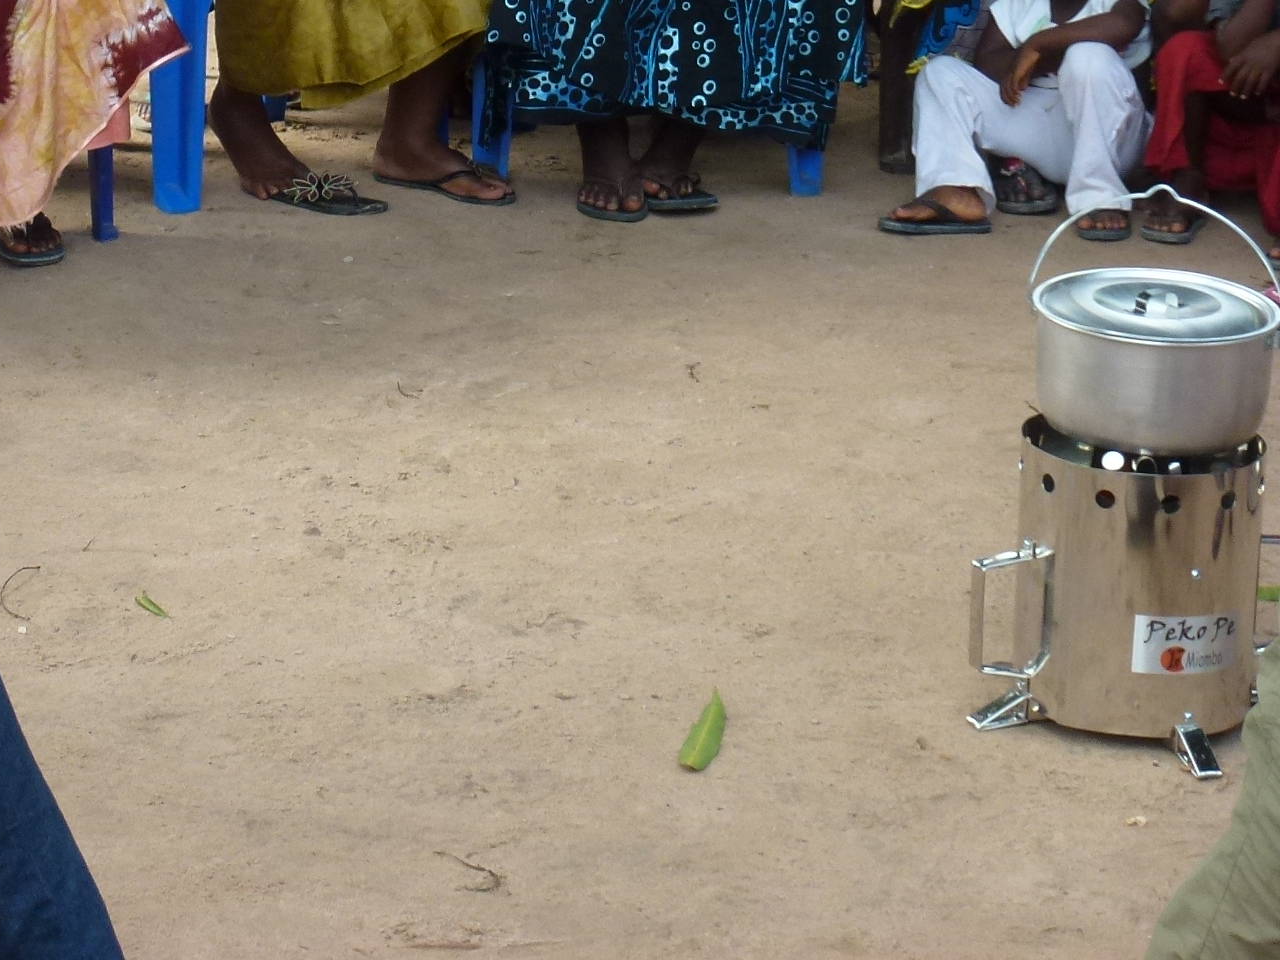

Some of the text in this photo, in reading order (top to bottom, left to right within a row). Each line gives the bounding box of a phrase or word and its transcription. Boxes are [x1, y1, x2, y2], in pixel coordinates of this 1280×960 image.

[1144, 616, 1236, 644] Peko Pe
[1185, 648, 1223, 670] Miombo
